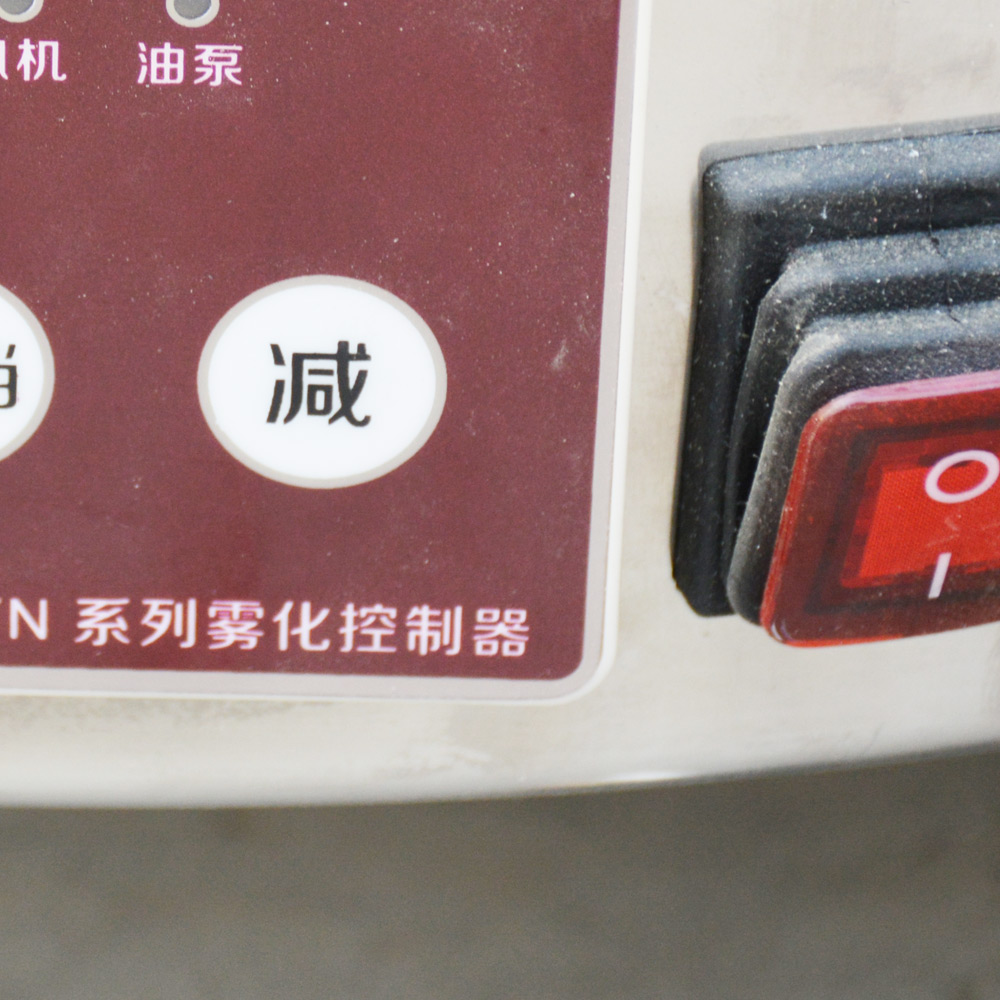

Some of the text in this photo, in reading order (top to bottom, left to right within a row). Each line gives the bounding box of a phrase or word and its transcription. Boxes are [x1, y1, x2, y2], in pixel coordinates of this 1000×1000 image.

[137, 42, 243, 88] 油泵
[267, 341, 370, 427] 减
[75, 597, 530, 658] 系列雾化控制器
